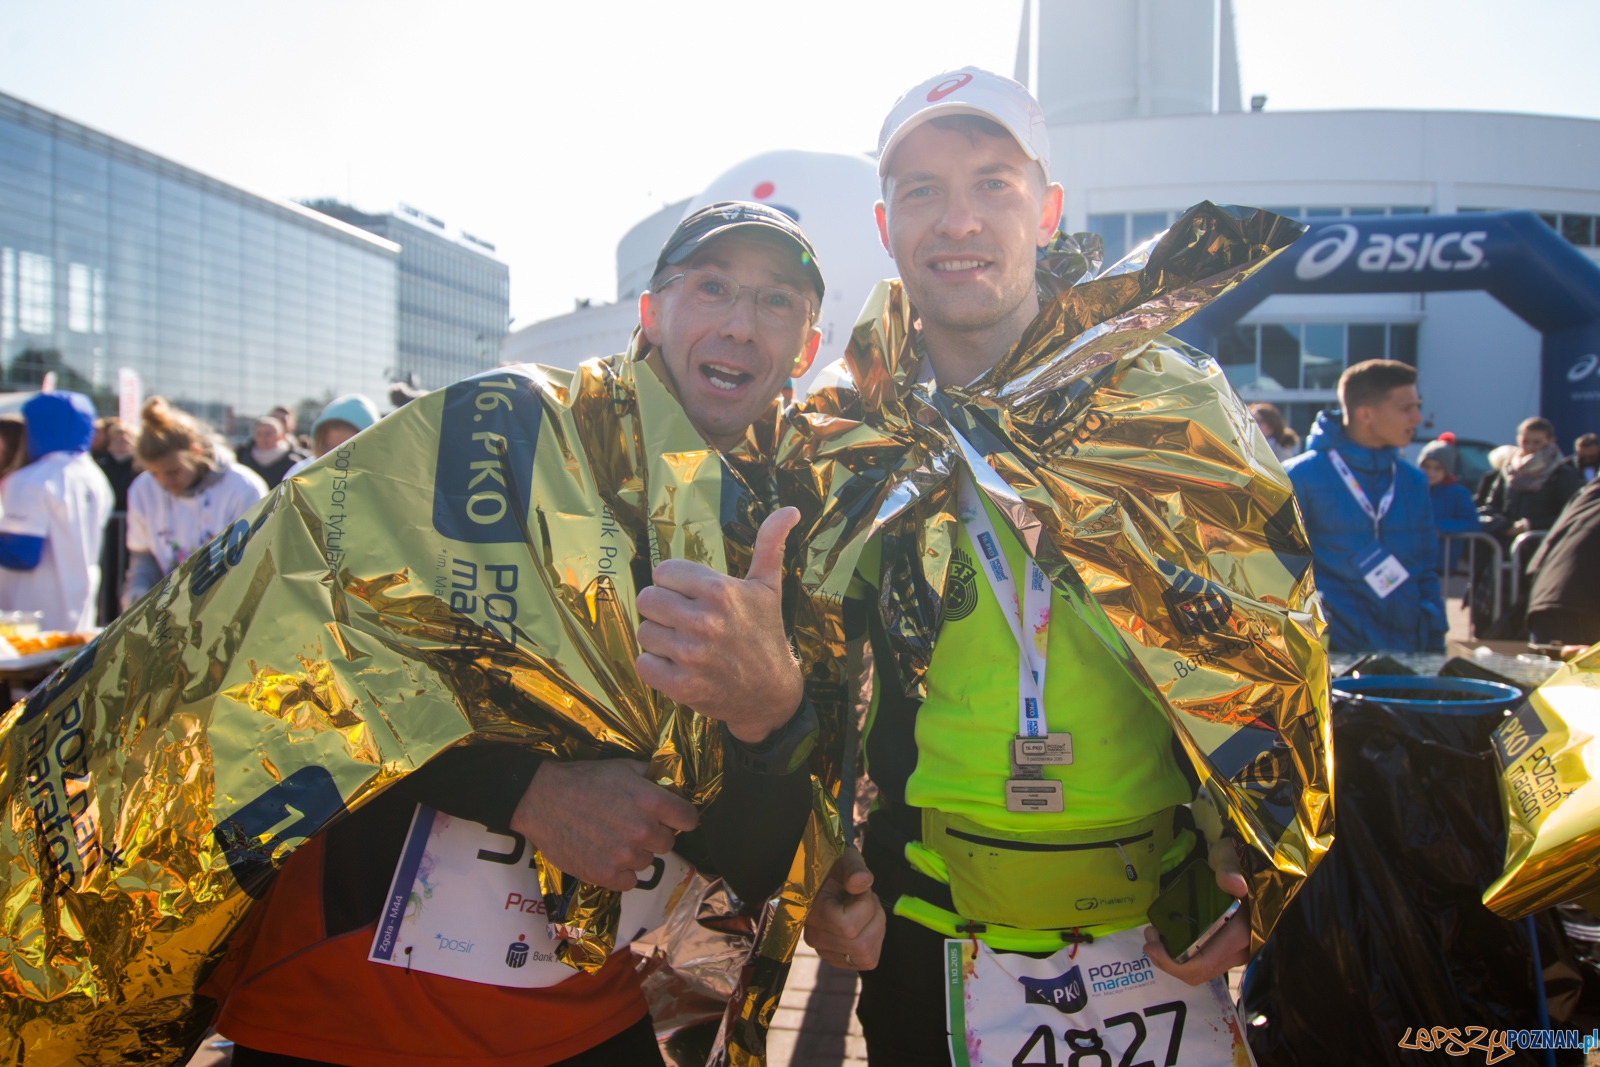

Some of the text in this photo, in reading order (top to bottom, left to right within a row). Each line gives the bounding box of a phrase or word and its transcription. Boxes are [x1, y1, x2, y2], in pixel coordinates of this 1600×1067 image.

[466, 377, 517, 525] 16. PKO
[331, 441, 356, 509] Sponsor
[600, 504, 620, 538] ank
[950, 564, 973, 581] EF
[1500, 716, 1531, 757] PKO
[1509, 764, 1542, 824] maraton
[389, 895, 404, 918] M44
[532, 950, 553, 963] Bank
[1053, 979, 1081, 1004] PKO
[1092, 969, 1155, 993] maraton
[1011, 1000, 1188, 1067] 4827
